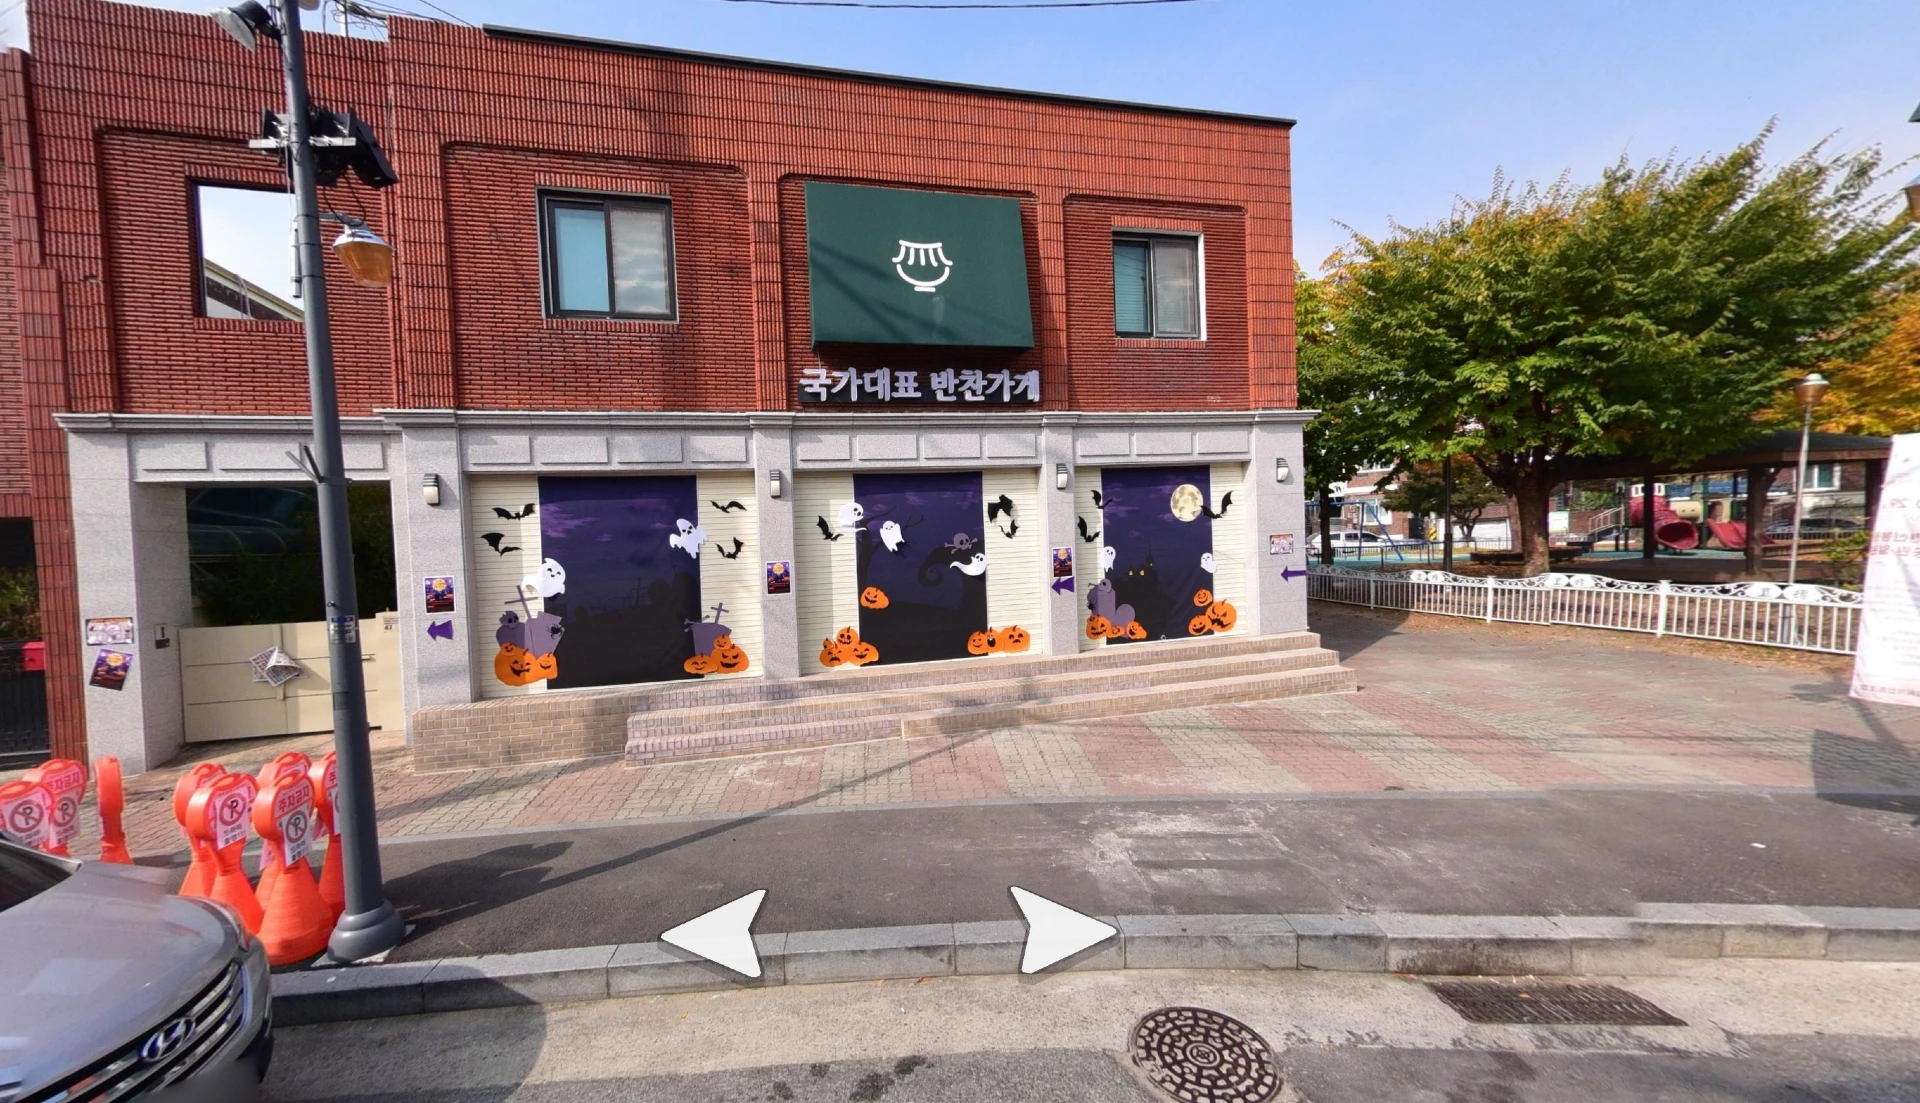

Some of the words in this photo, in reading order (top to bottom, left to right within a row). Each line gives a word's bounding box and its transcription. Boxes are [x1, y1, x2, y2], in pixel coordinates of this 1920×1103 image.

[799, 367, 922, 402] 국가대표
[930, 368, 1040, 402] 반찬가게
[278, 786, 310, 812] 주차금지
